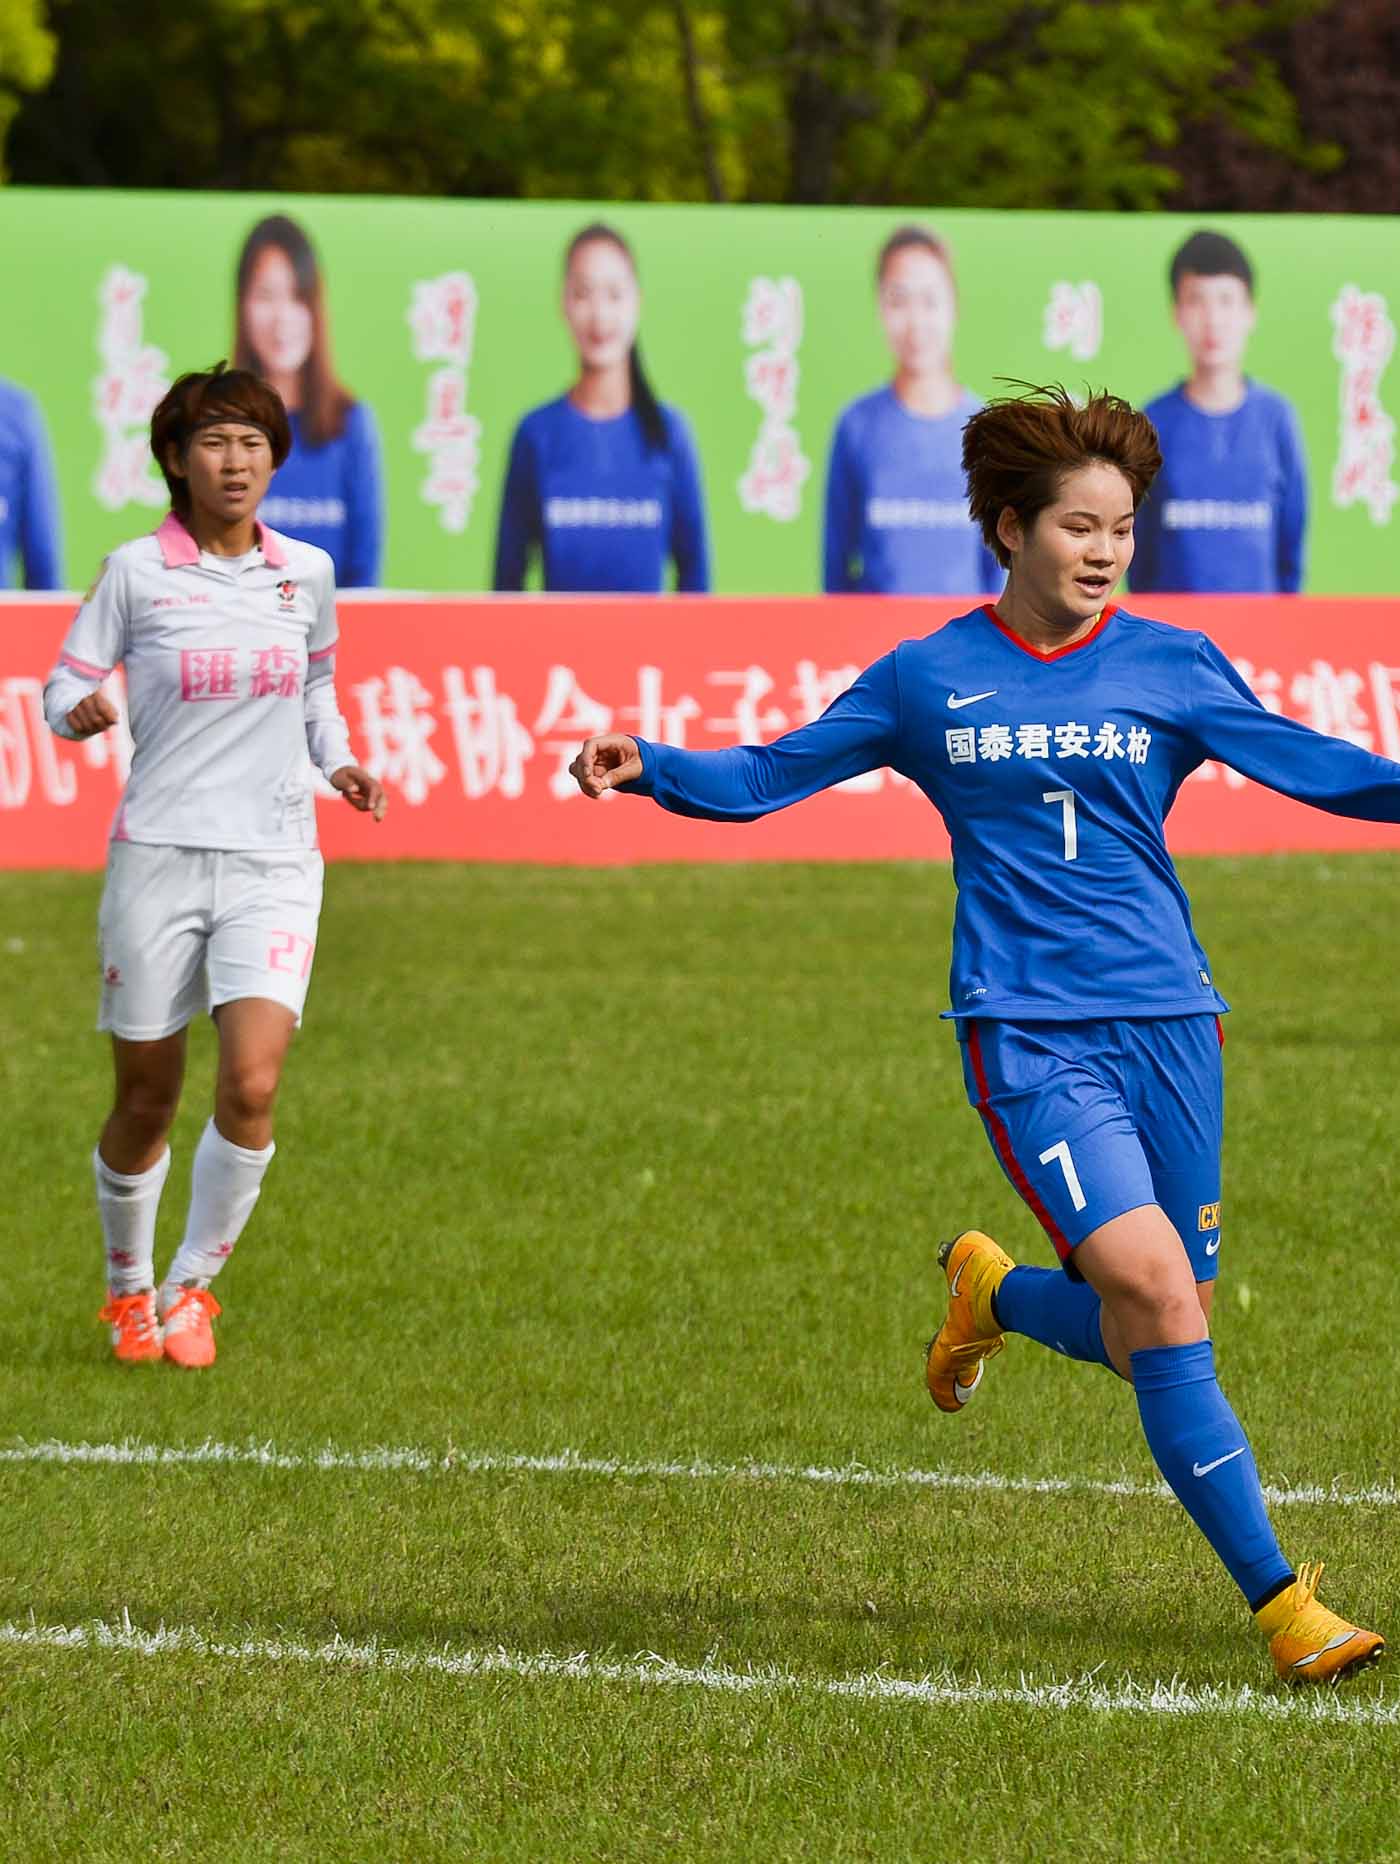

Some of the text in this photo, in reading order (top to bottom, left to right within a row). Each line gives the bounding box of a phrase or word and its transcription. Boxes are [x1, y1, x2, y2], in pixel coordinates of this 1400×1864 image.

[945, 721, 1152, 765] 国泰君安永柏
[1043, 790, 1077, 861] 7
[1038, 1139, 1087, 1212] 7
